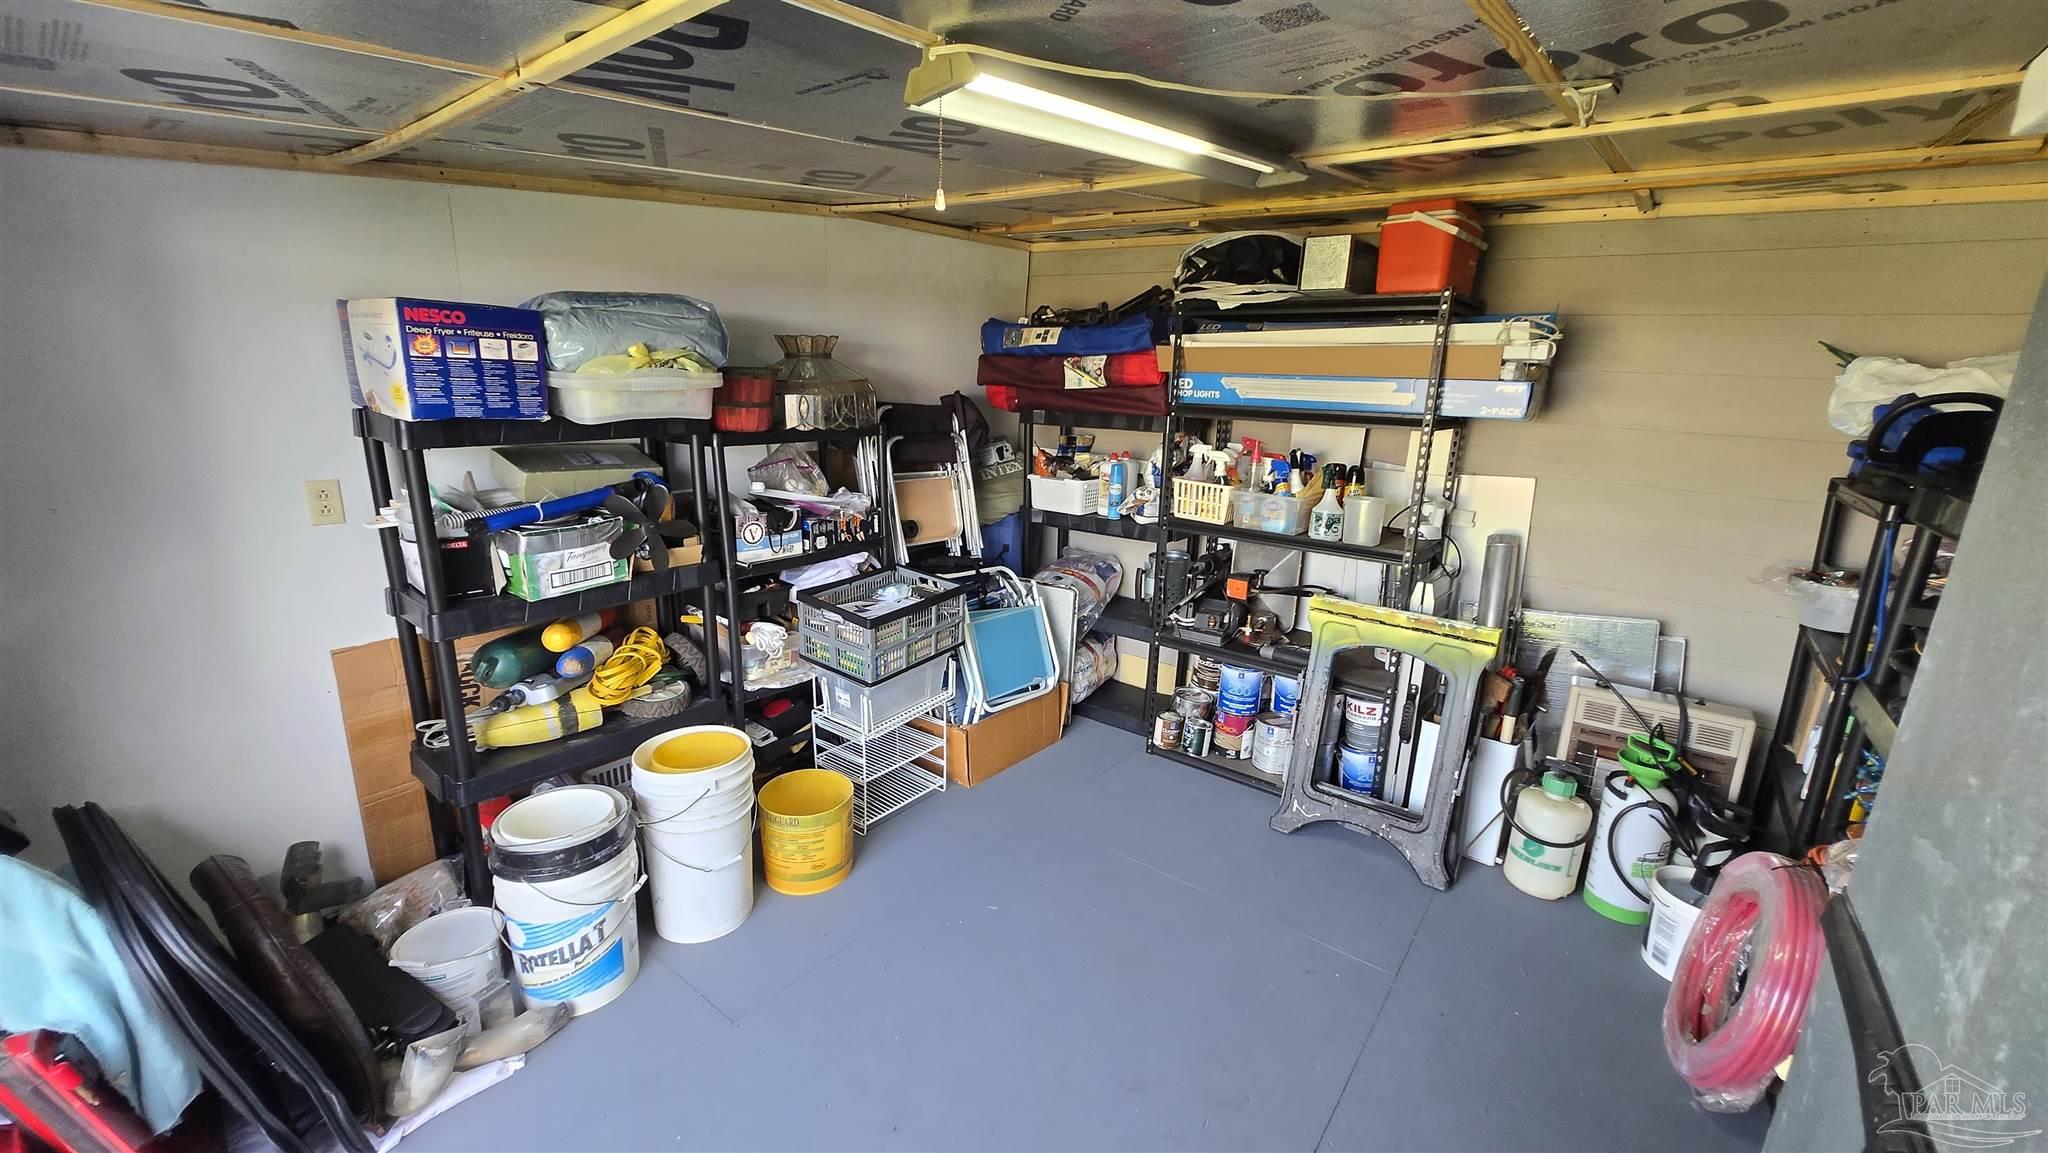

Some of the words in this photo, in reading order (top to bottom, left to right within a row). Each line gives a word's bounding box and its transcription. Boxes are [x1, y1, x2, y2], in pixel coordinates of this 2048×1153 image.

[1727, 19, 1816, 47] FOAM
[1352, 22, 1479, 75] INSULATION
[403, 306, 467, 324] NESCO
[405, 325, 432, 335] Deep
[433, 326, 455, 337] Fryer
[463, 328, 495, 338] Friteuse
[502, 331, 535, 341] Freidora
[1178, 377, 1194, 390] ED
[1177, 389, 1193, 397] HOP
[1193, 390, 1221, 399] LIGHTS
[1480, 405, 1523, 418] 2-PACK
[980, 459, 1023, 481] INTEX
[1346, 701, 1378, 717] KILZ
[518, 934, 595, 975] ROTELLA
